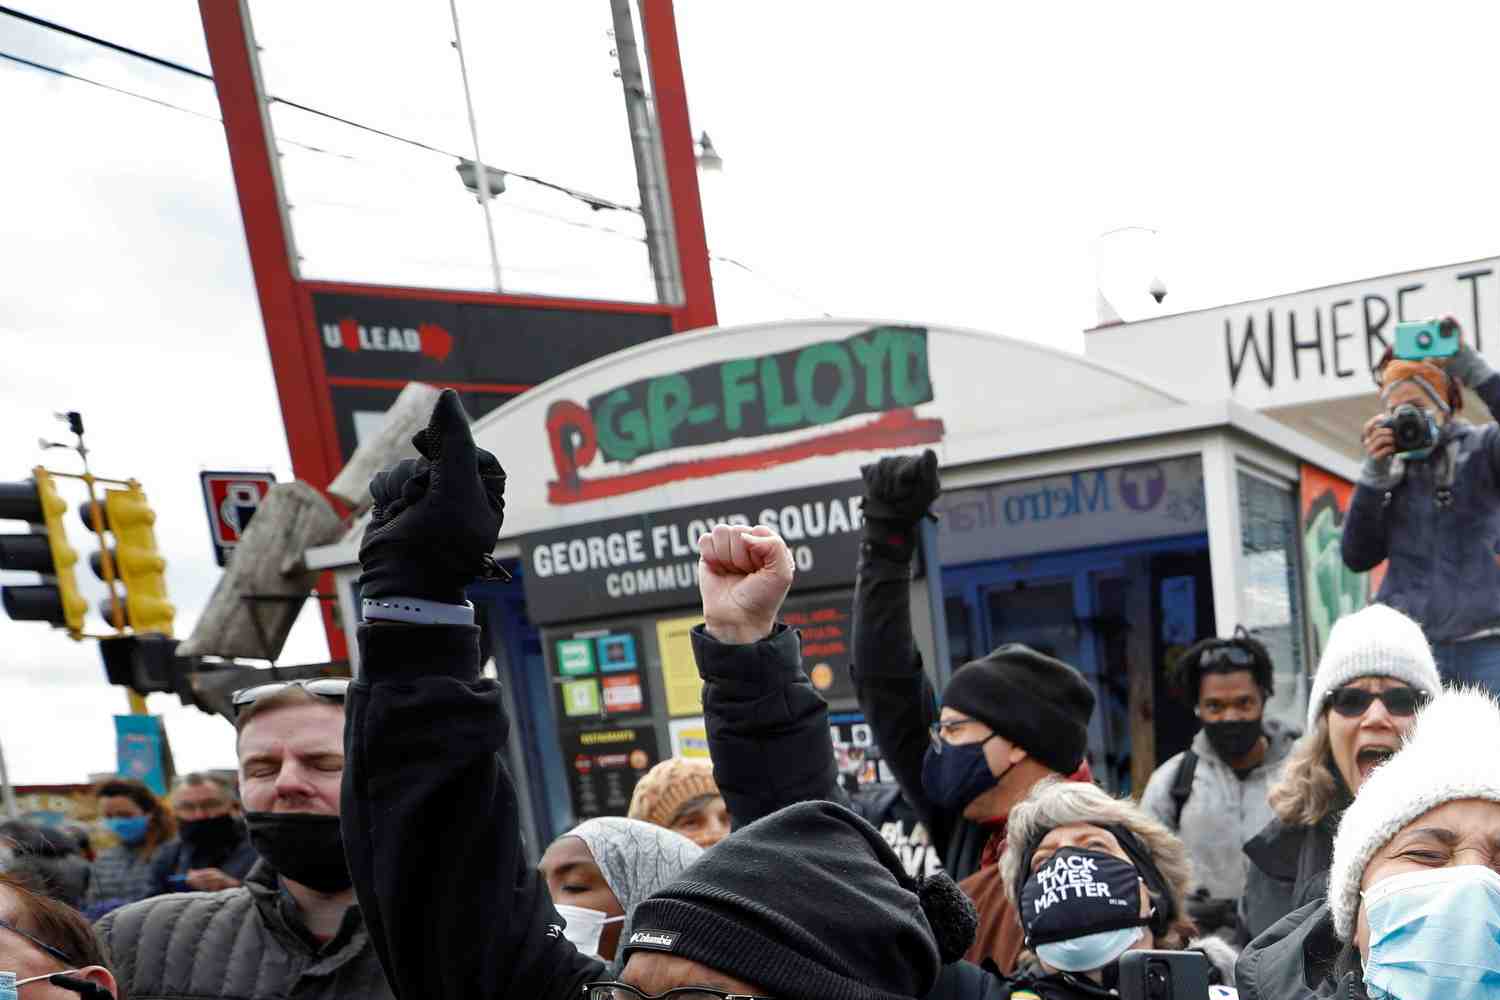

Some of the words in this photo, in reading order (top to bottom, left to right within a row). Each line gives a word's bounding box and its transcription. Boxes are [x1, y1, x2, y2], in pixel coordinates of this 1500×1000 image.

[532, 527, 649, 578] GEORGE
[758, 496, 866, 542] SQUAR
[606, 562, 700, 598] COMMU
[1036, 855, 1099, 885] BLACK
[1042, 869, 1094, 895] LIVES
[1033, 881, 1111, 915] MATTER
